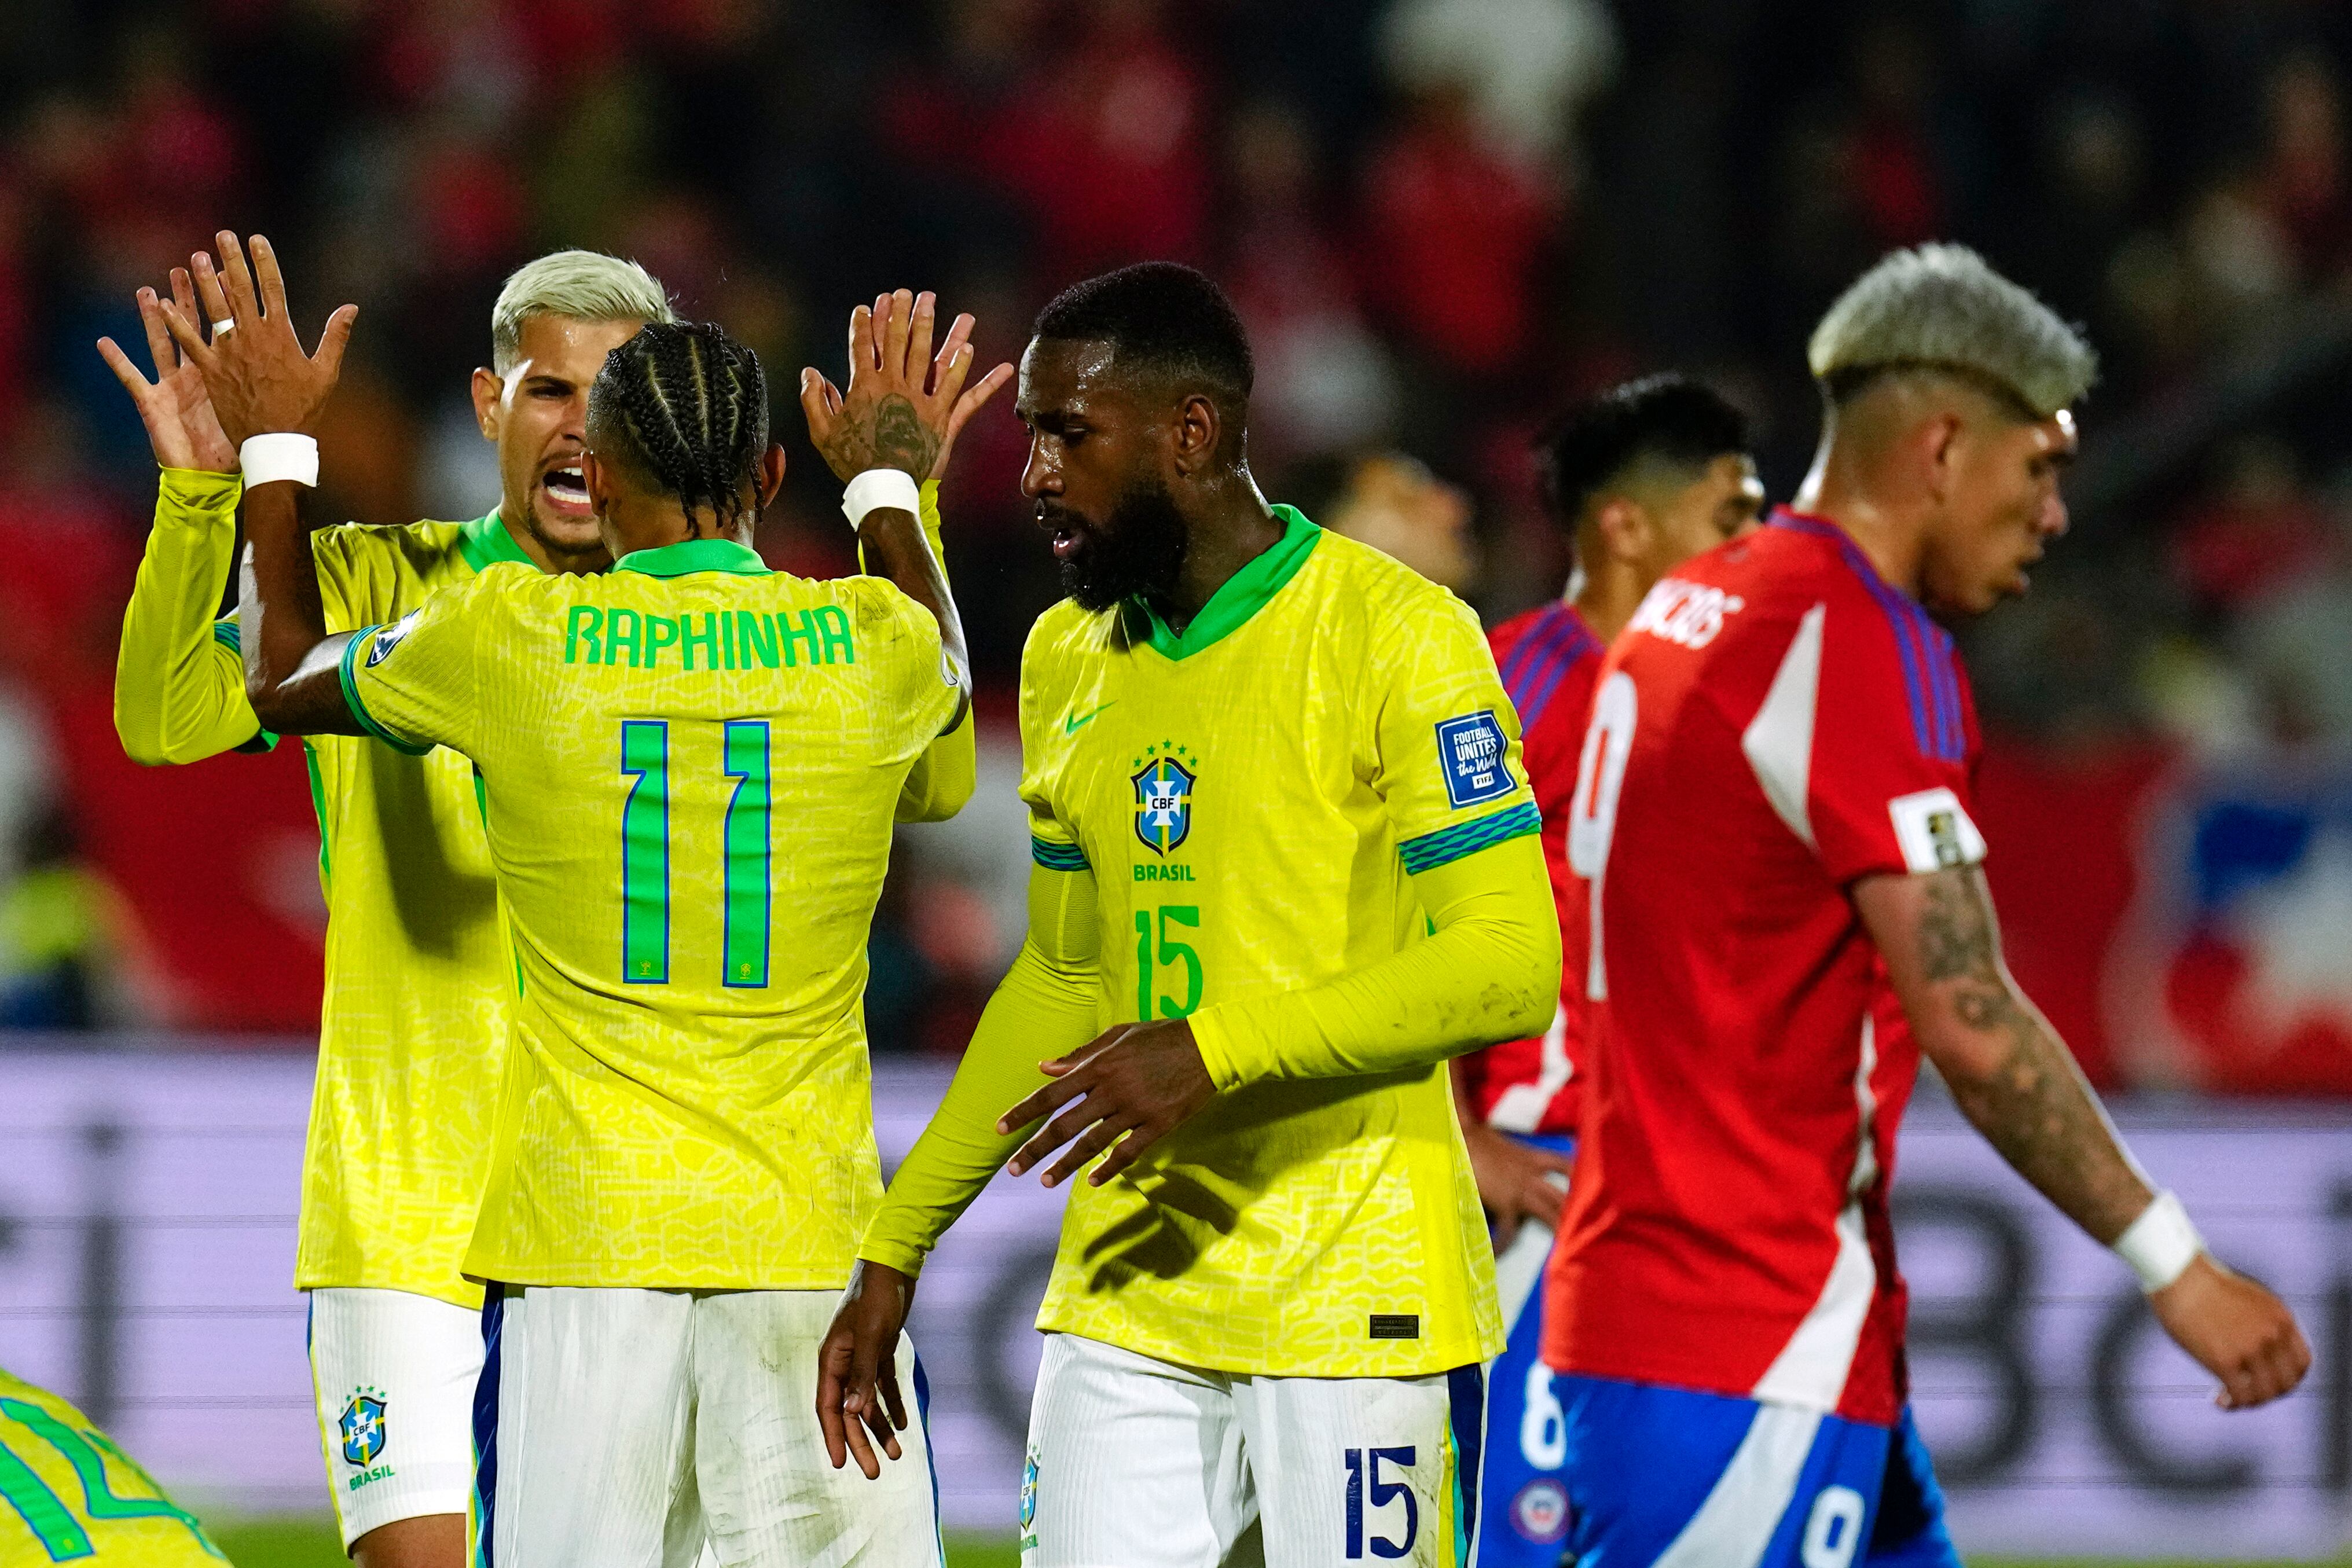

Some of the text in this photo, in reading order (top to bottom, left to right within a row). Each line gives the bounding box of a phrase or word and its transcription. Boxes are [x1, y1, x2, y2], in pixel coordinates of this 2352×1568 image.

[565, 605, 854, 671] RAPHINHA
[1453, 726, 1495, 746] FOOTBALL
[1455, 737, 1497, 761] UNITES
[1456, 761, 1475, 777] the
[1152, 798, 1175, 809] CBF
[621, 720, 772, 989] 11
[1133, 864, 1197, 882] BRASIL
[1135, 905, 1203, 1022] 15
[354, 1423, 370, 1437] CBF
[349, 1464, 395, 1491] BRASIL
[1345, 1445, 1418, 1559] 15
